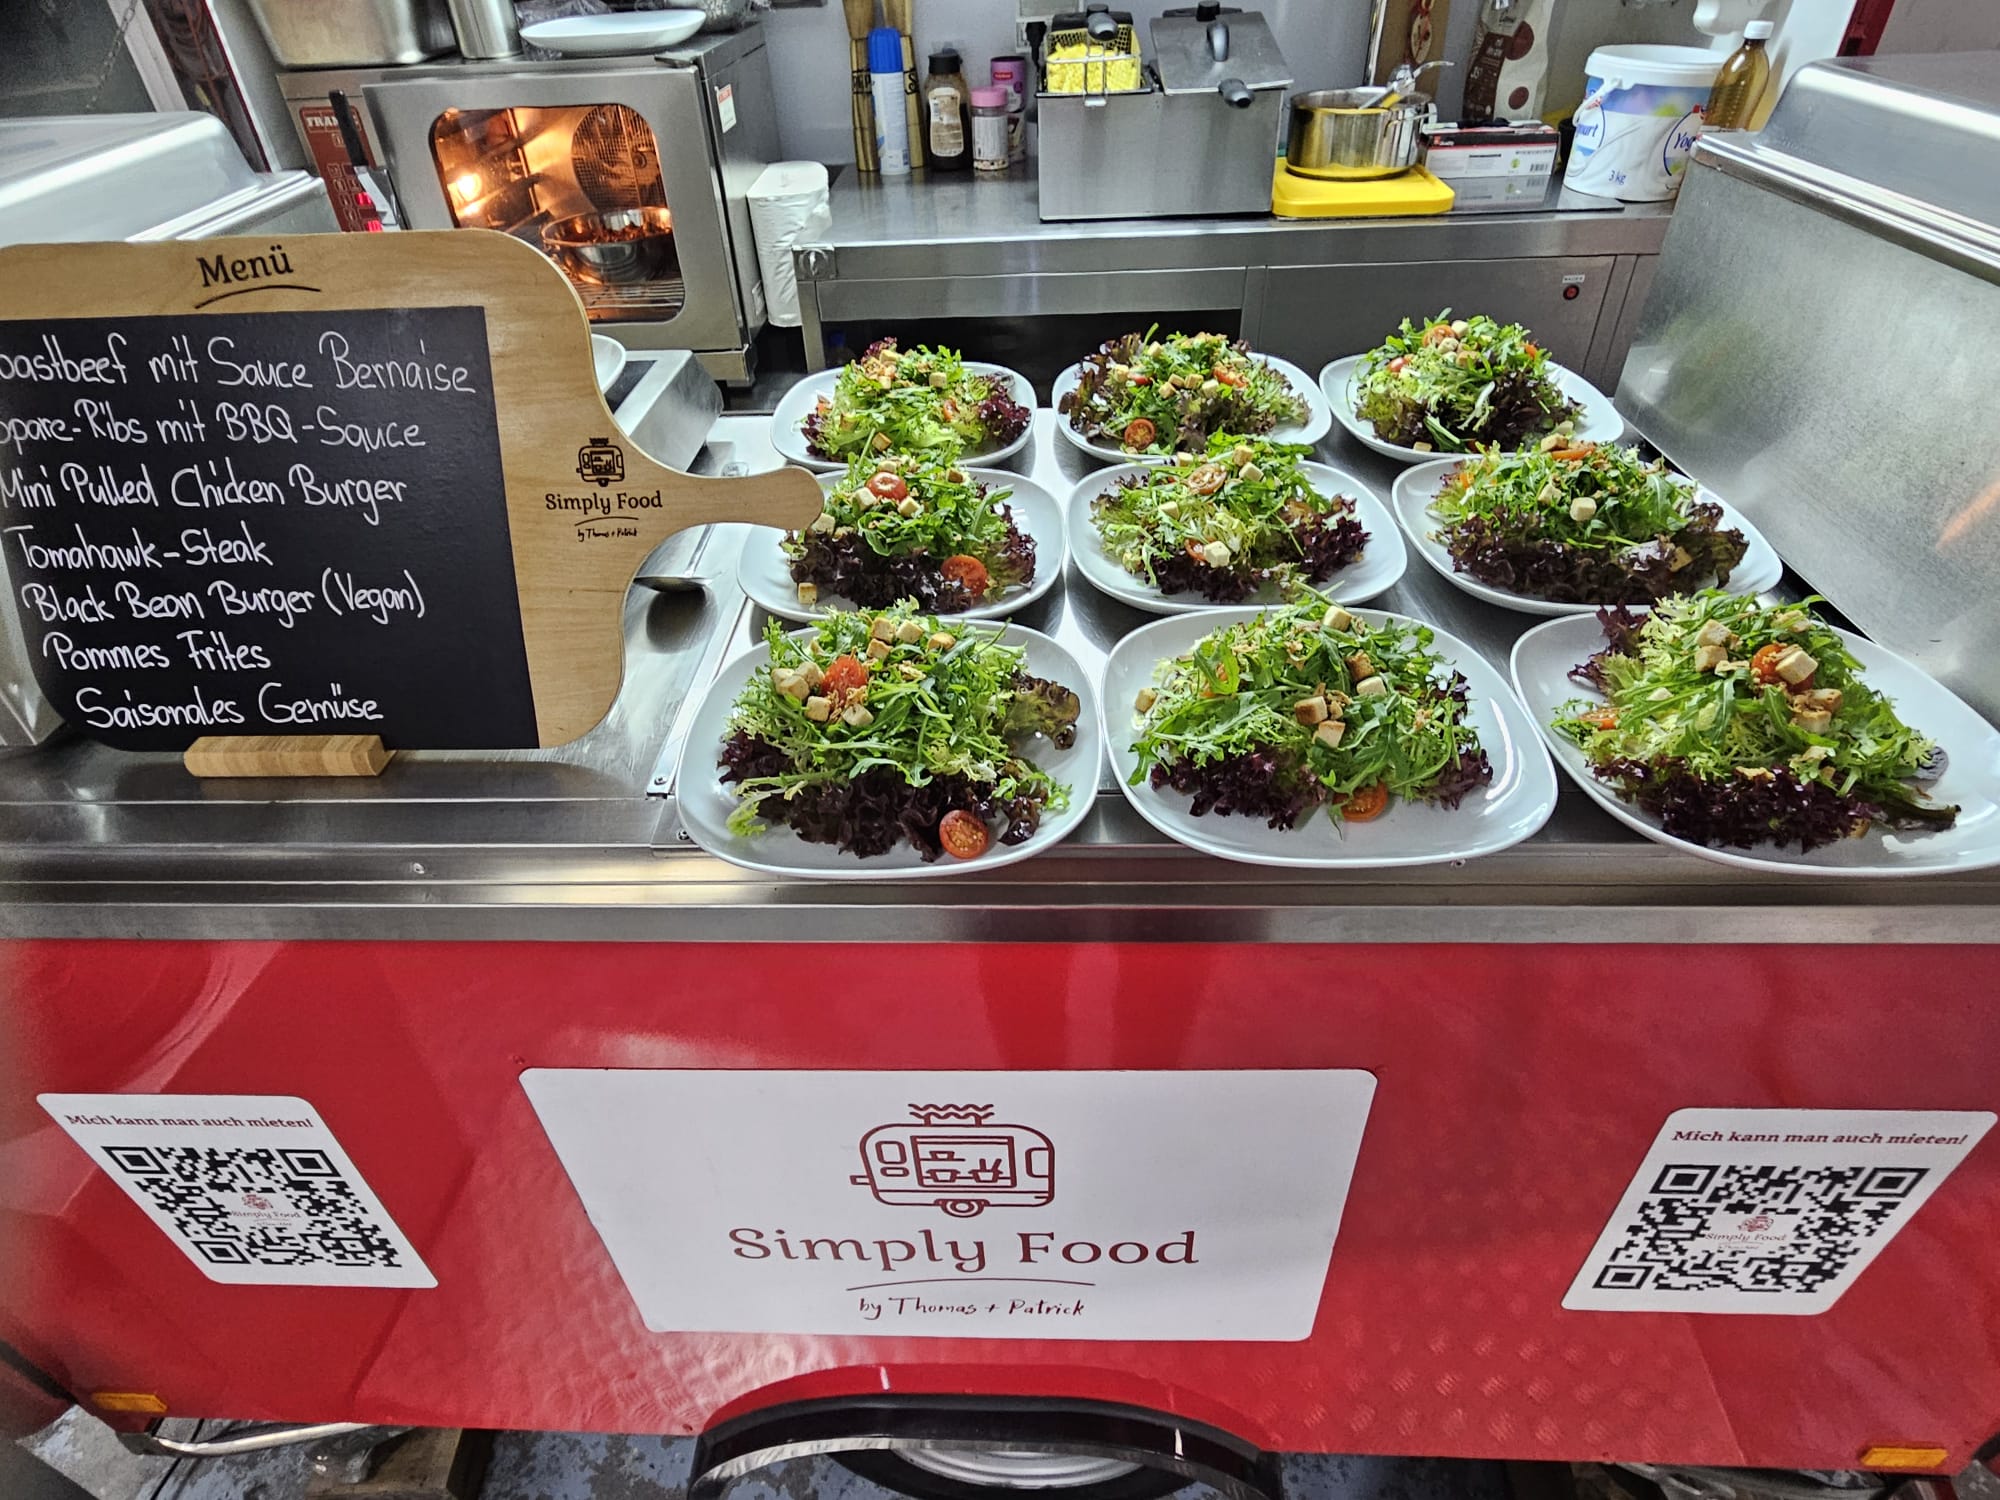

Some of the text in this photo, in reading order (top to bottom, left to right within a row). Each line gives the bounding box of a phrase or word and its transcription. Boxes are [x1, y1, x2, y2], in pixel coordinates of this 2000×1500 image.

[196, 244, 294, 288] Menü
[0, 331, 476, 393] oastbeef mit Sauce Bernaise
[156, 399, 205, 444] mit
[0, 456, 407, 526] Mini Pulled Chicken Burger
[545, 490, 663, 515] Simply Food
[3, 520, 273, 571] Tomahawk-Steak
[21, 567, 425, 628] Black Bean Burger (Vegan)
[43, 630, 271, 671] Pommes Frites
[76, 682, 384, 728] Saisonales Gemüse
[65, 1114, 314, 1129] Mich kann man auch mieten!
[1672, 1130, 1968, 1146] Mich kann man auch mieten!
[728, 1227, 1199, 1273] Simply Food
[859, 1297, 1085, 1320] by Thomas + Patrick
